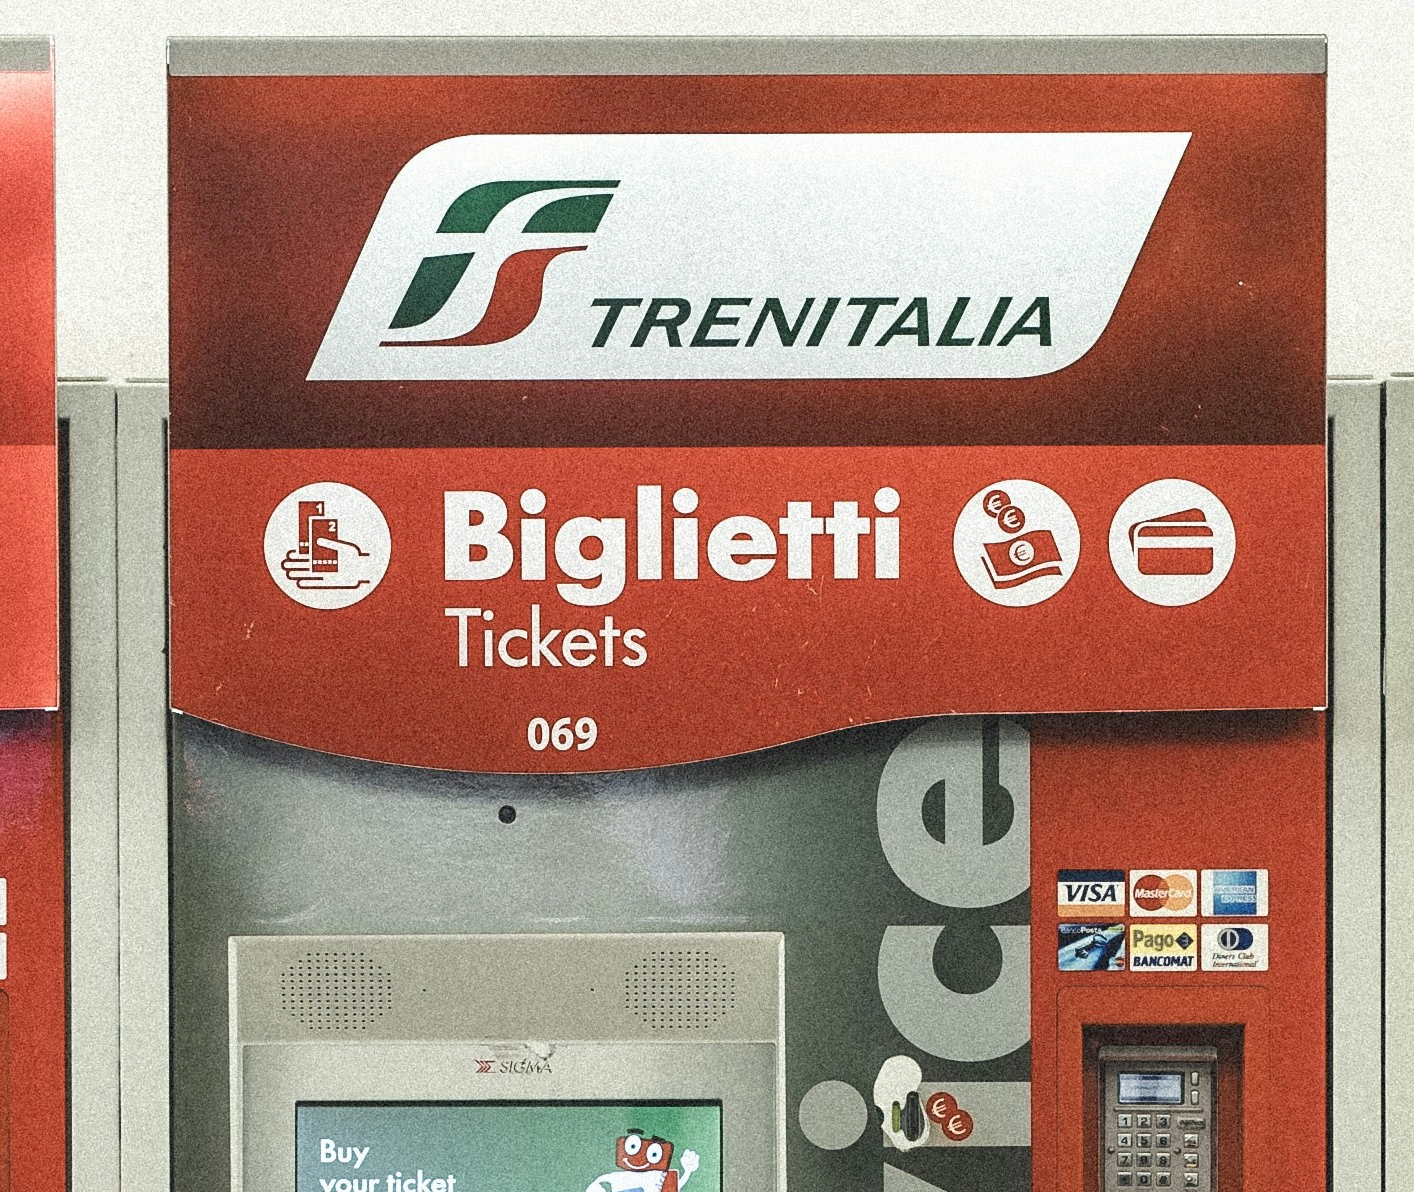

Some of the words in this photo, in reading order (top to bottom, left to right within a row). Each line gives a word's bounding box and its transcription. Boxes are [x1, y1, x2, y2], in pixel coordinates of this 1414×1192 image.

[591, 297, 1053, 348] TRENITALIA
[442, 485, 901, 604] Biglietti
[445, 605, 648, 669] Tickets
[527, 716, 597, 752] 069
[1065, 883, 1118, 902] VISA
[1134, 888, 1193, 899] MasterCard
[1133, 929, 1174, 951] Pago
[1133, 955, 1195, 967] BANCOMAT
[499, 1060, 553, 1074] SIGMA
[1140, 1116, 1148, 1127] 2
[1120, 1136, 1128, 1146] 4
[320, 1138, 370, 1169] Buy
